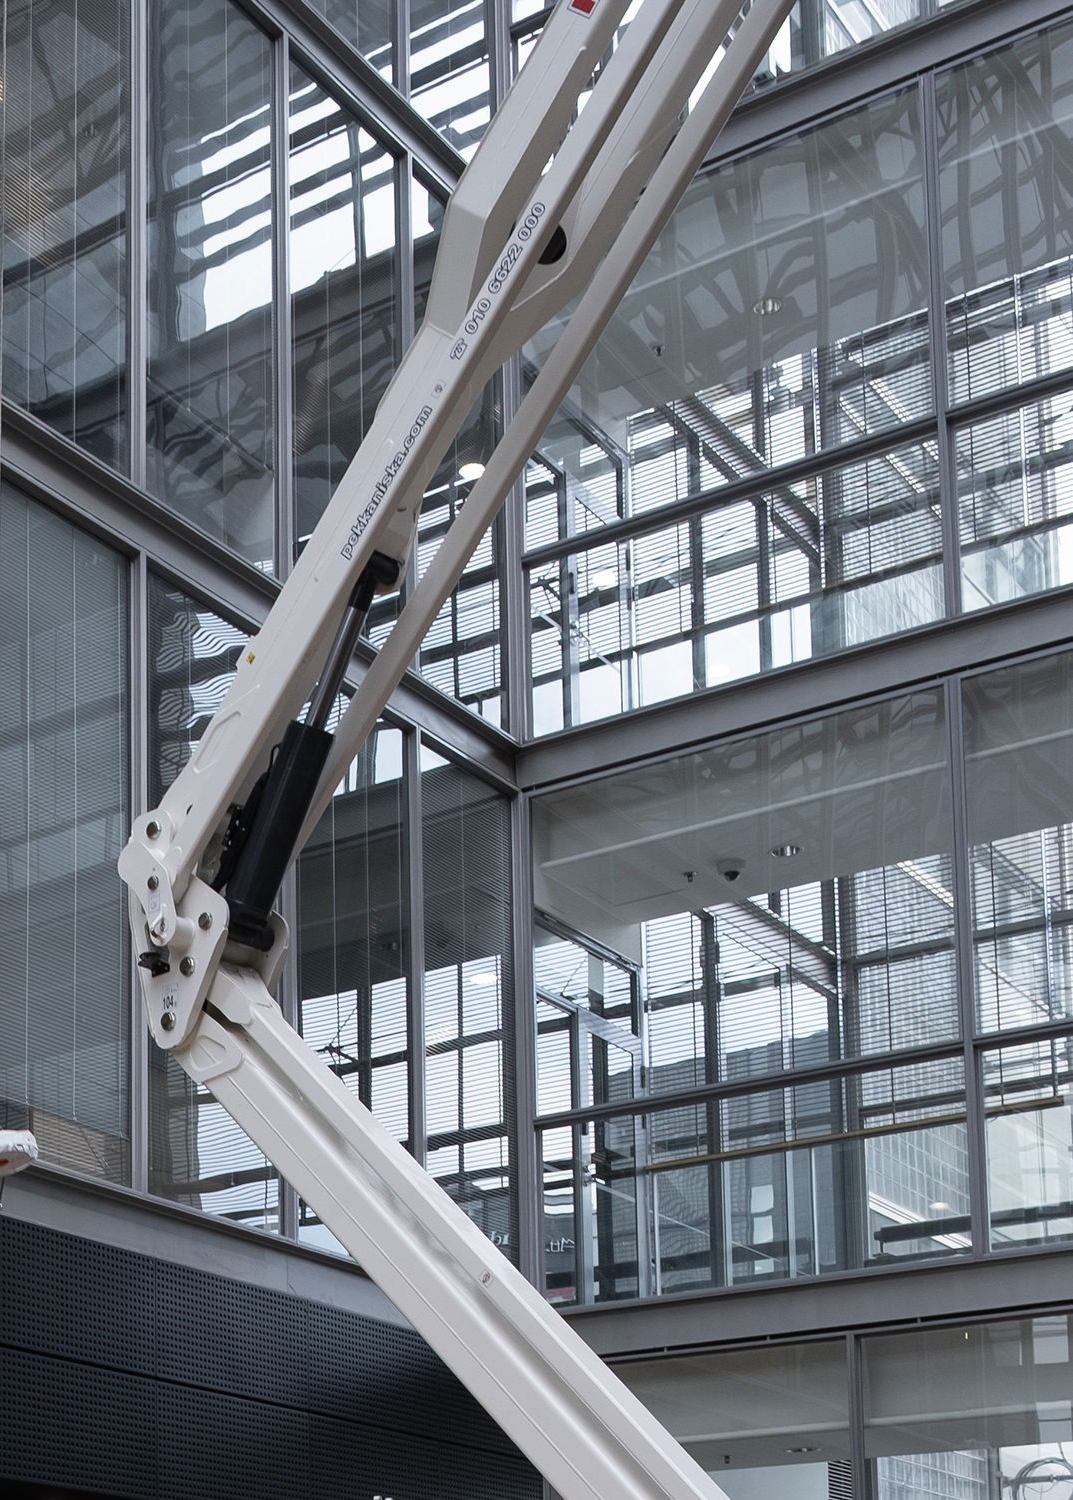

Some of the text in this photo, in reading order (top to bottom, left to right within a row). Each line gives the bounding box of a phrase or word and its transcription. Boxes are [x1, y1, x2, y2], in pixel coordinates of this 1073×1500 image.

[465, 202, 546, 335] 010 6622 000
[340, 405, 433, 561] pekkaniska.com
